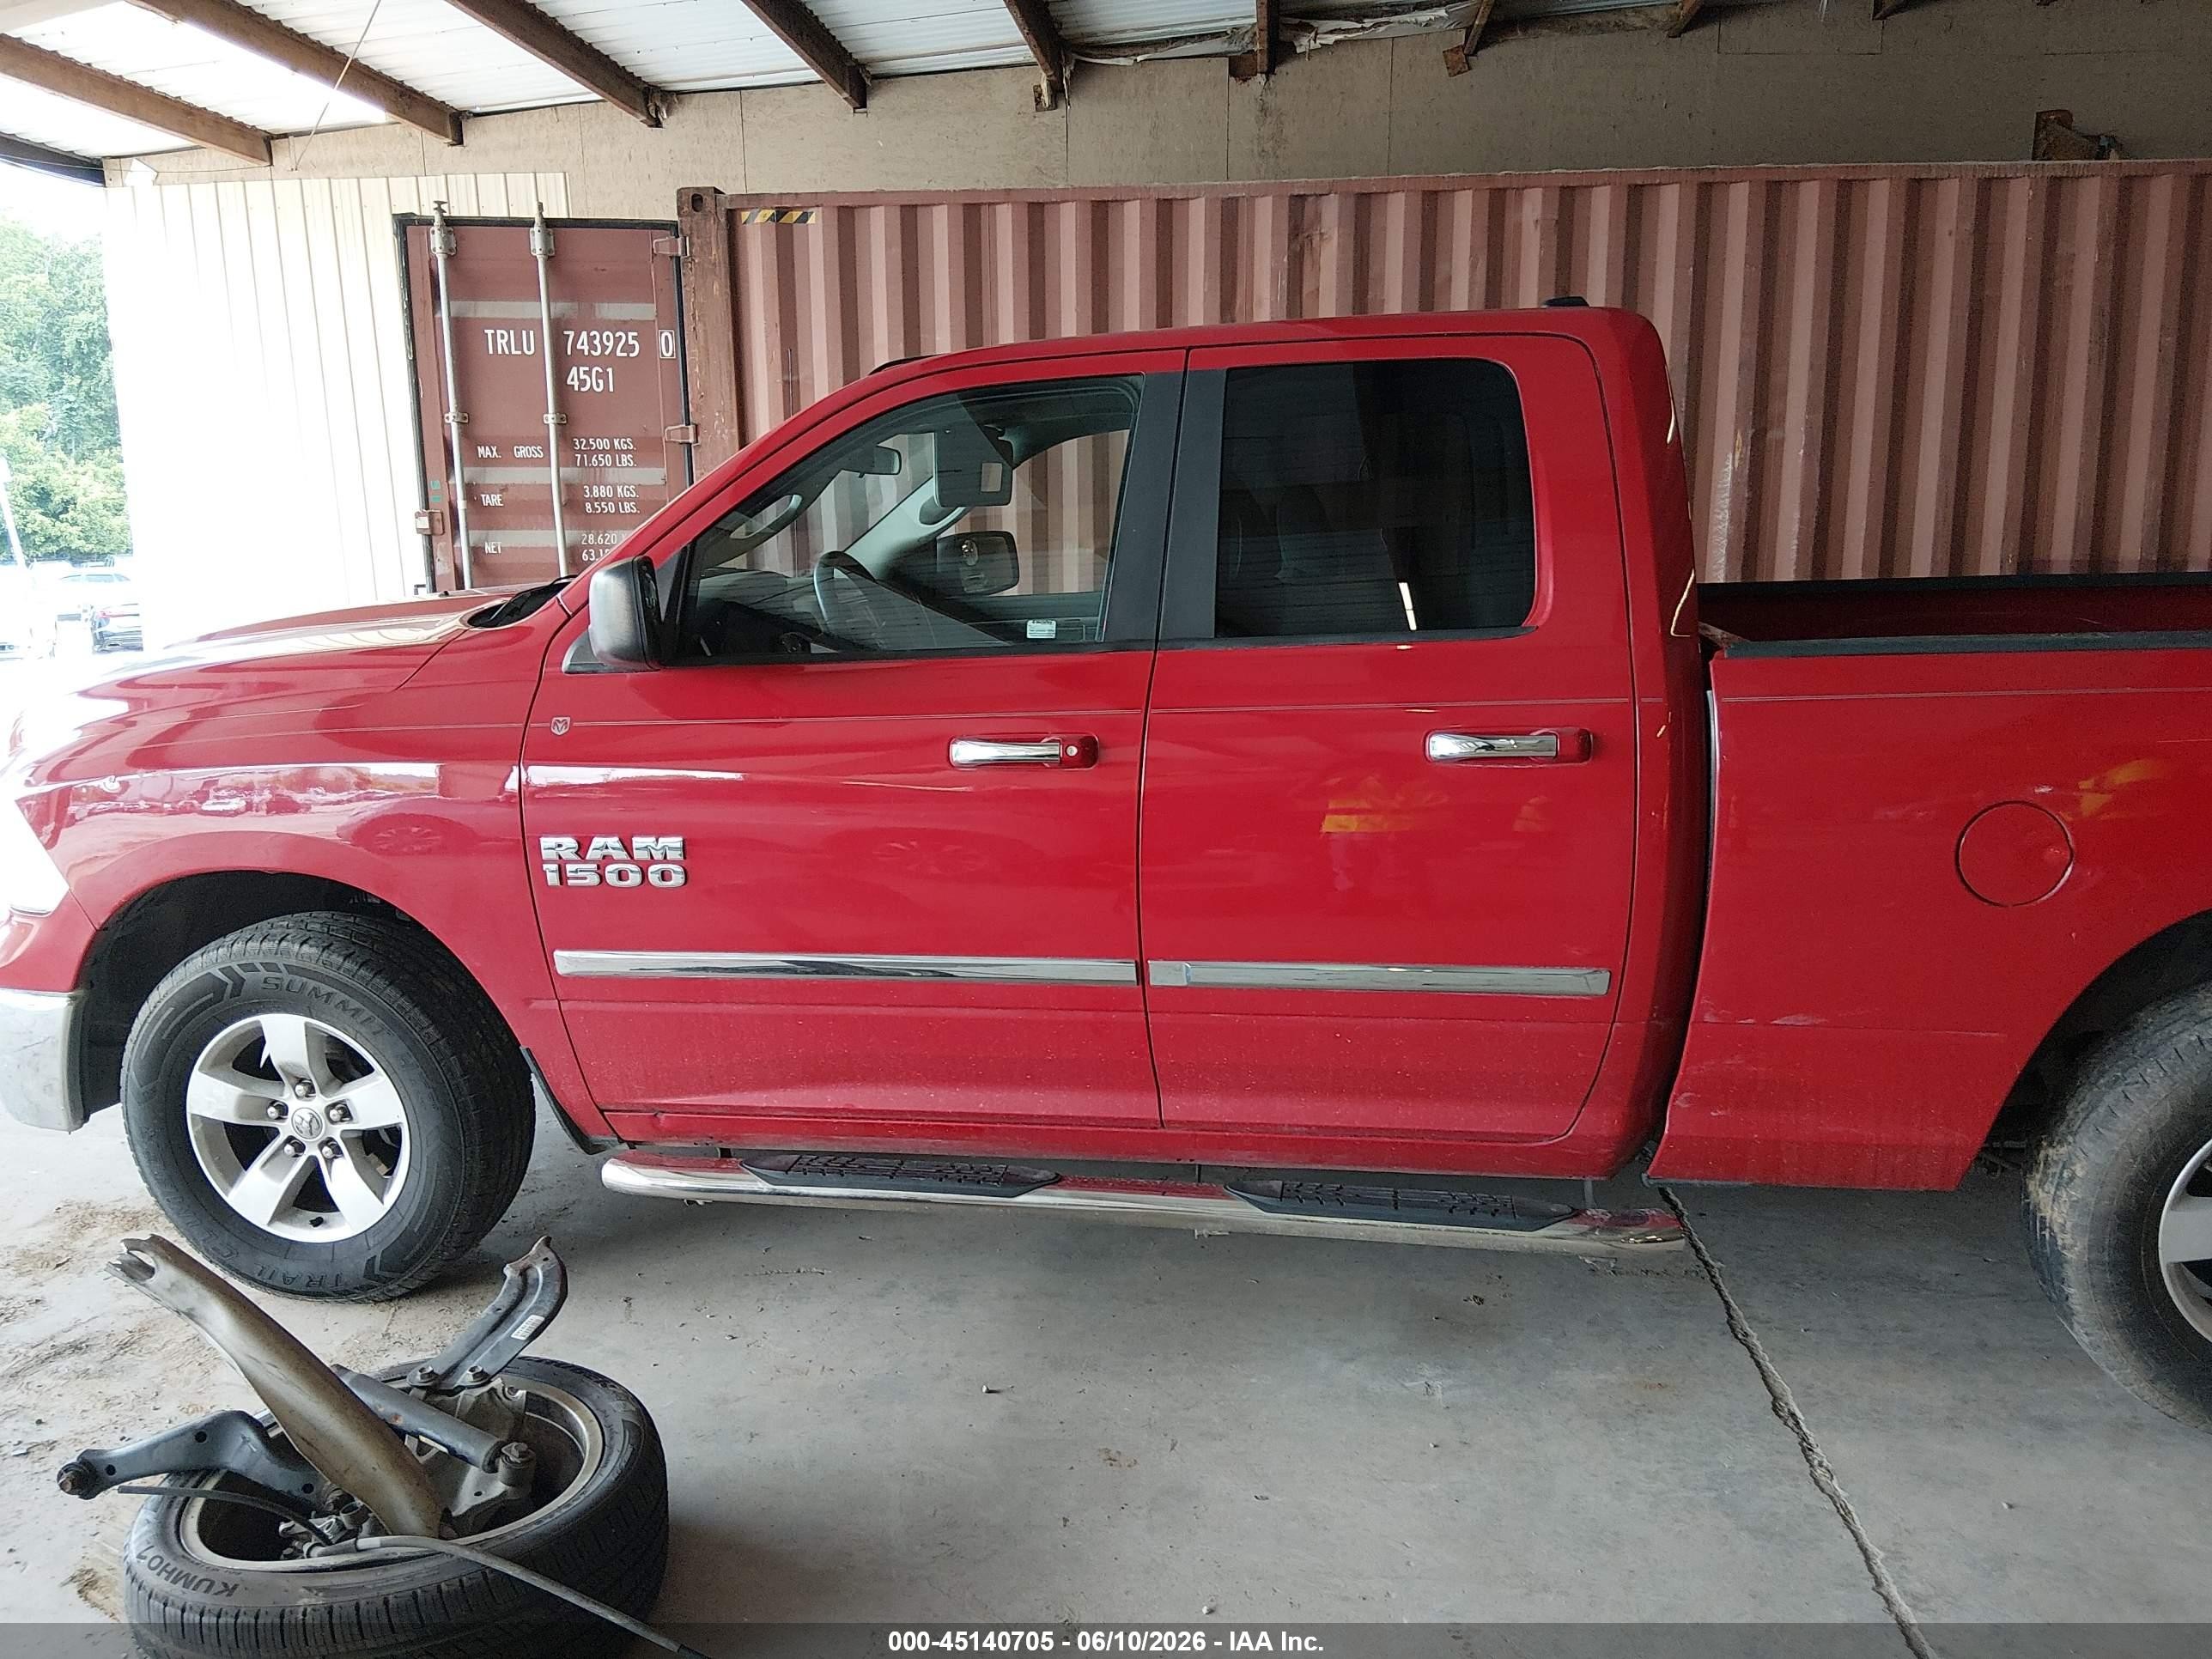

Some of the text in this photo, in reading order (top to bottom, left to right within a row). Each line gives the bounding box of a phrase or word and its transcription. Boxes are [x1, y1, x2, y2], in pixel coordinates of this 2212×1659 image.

[483, 330, 673, 357] TRLU 743925 0
[567, 366, 614, 392] 45G1
[573, 438, 637, 452] 32.500 KGS.
[477, 446, 544, 459] MAX. GROSS
[575, 453, 637, 467] 71.650 LBS.
[584, 485, 640, 498] 3.880 KGS.
[481, 494, 504, 507] TARE
[586, 501, 641, 514] 8.550 LBS.
[581, 533, 617, 545] 28.620
[484, 541, 502, 554] NET
[539, 836, 686, 861] RAM
[542, 863, 687, 888] 1500
[258, 975, 396, 1037] SUMMIT
